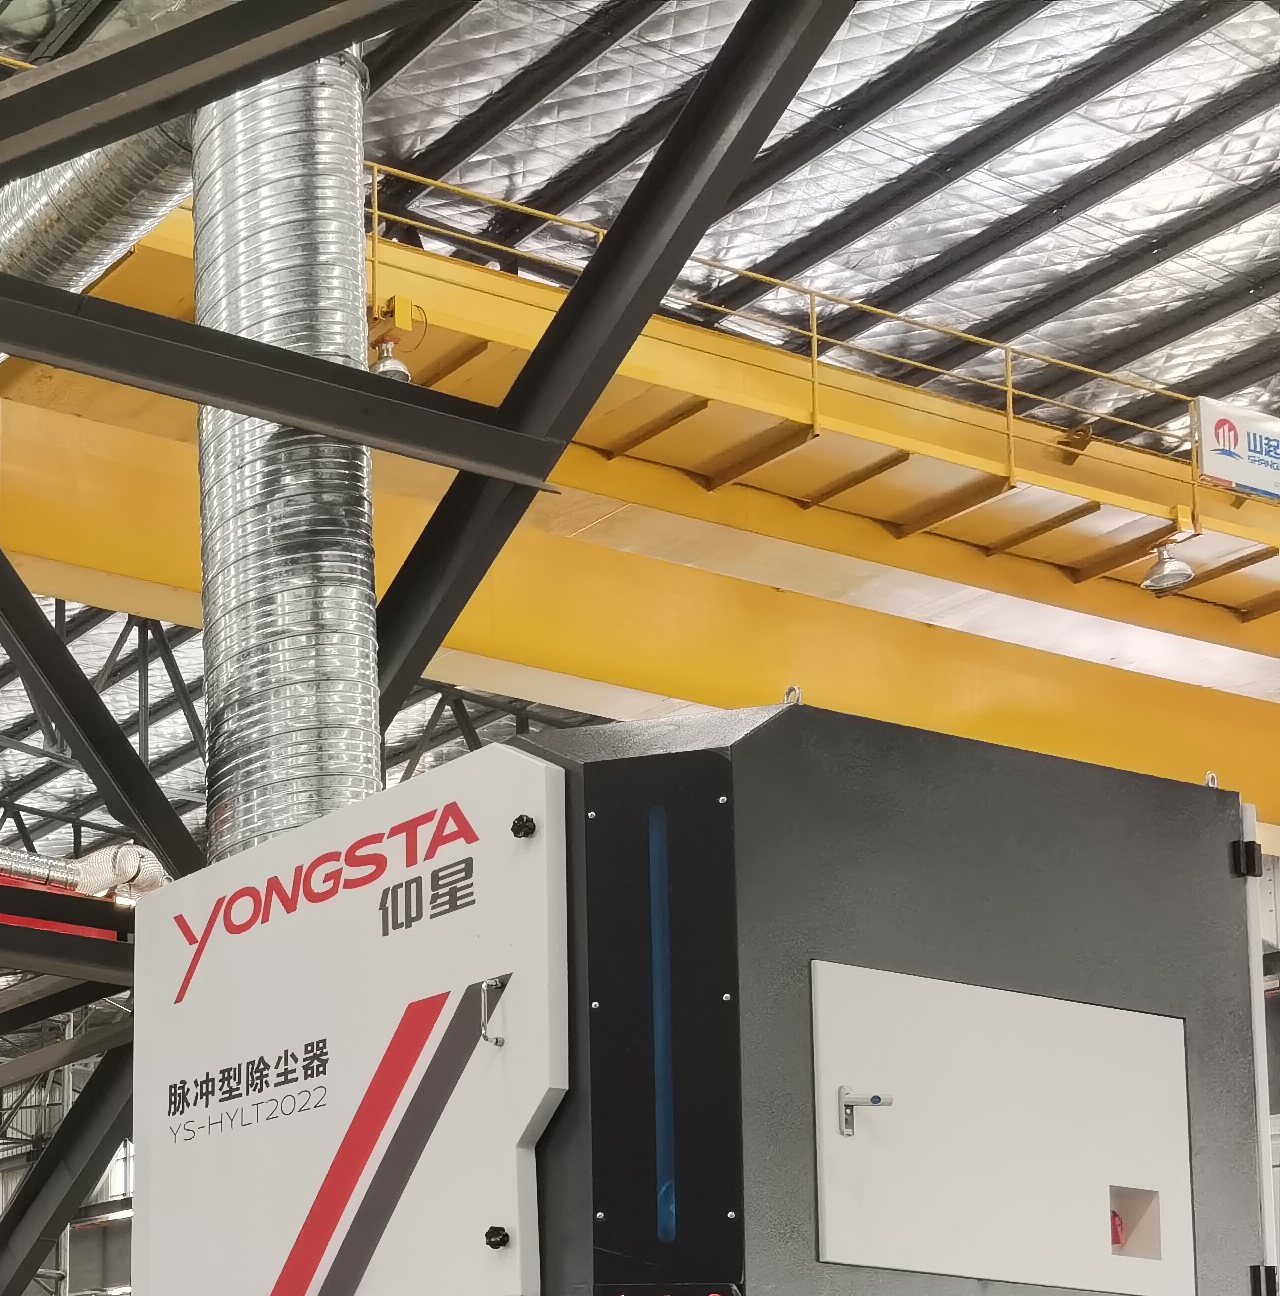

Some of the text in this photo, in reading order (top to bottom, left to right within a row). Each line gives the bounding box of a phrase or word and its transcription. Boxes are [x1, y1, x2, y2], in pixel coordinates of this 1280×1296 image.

[173, 801, 480, 1004] YONGSTA
[379, 856, 477, 937] 仰星
[167, 1038, 330, 1117] 脉冲型除尘器
[169, 1085, 328, 1144] YS-HYLT2022
